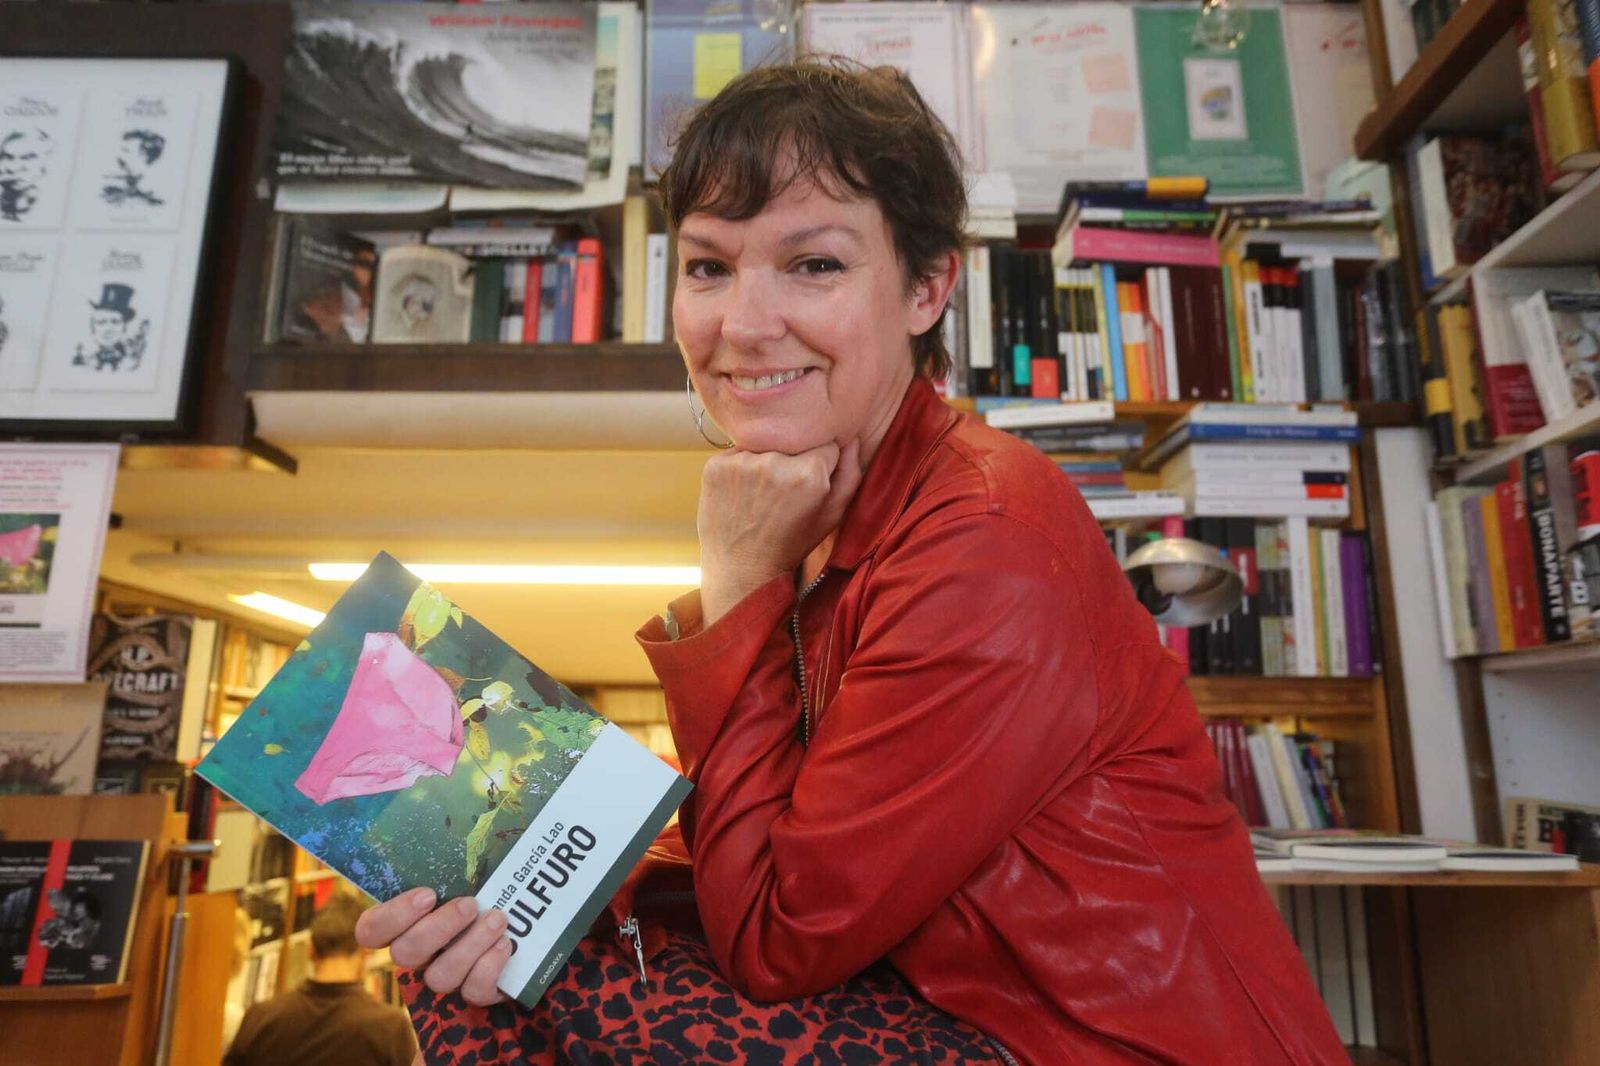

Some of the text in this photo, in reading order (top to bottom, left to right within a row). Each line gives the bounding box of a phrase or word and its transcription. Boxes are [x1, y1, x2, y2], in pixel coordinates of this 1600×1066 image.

[1538, 515, 1566, 618] BONAPARTE
[513, 844, 547, 882] García
[542, 822, 564, 844] Lao
[540, 952, 563, 984] CANDAYA
